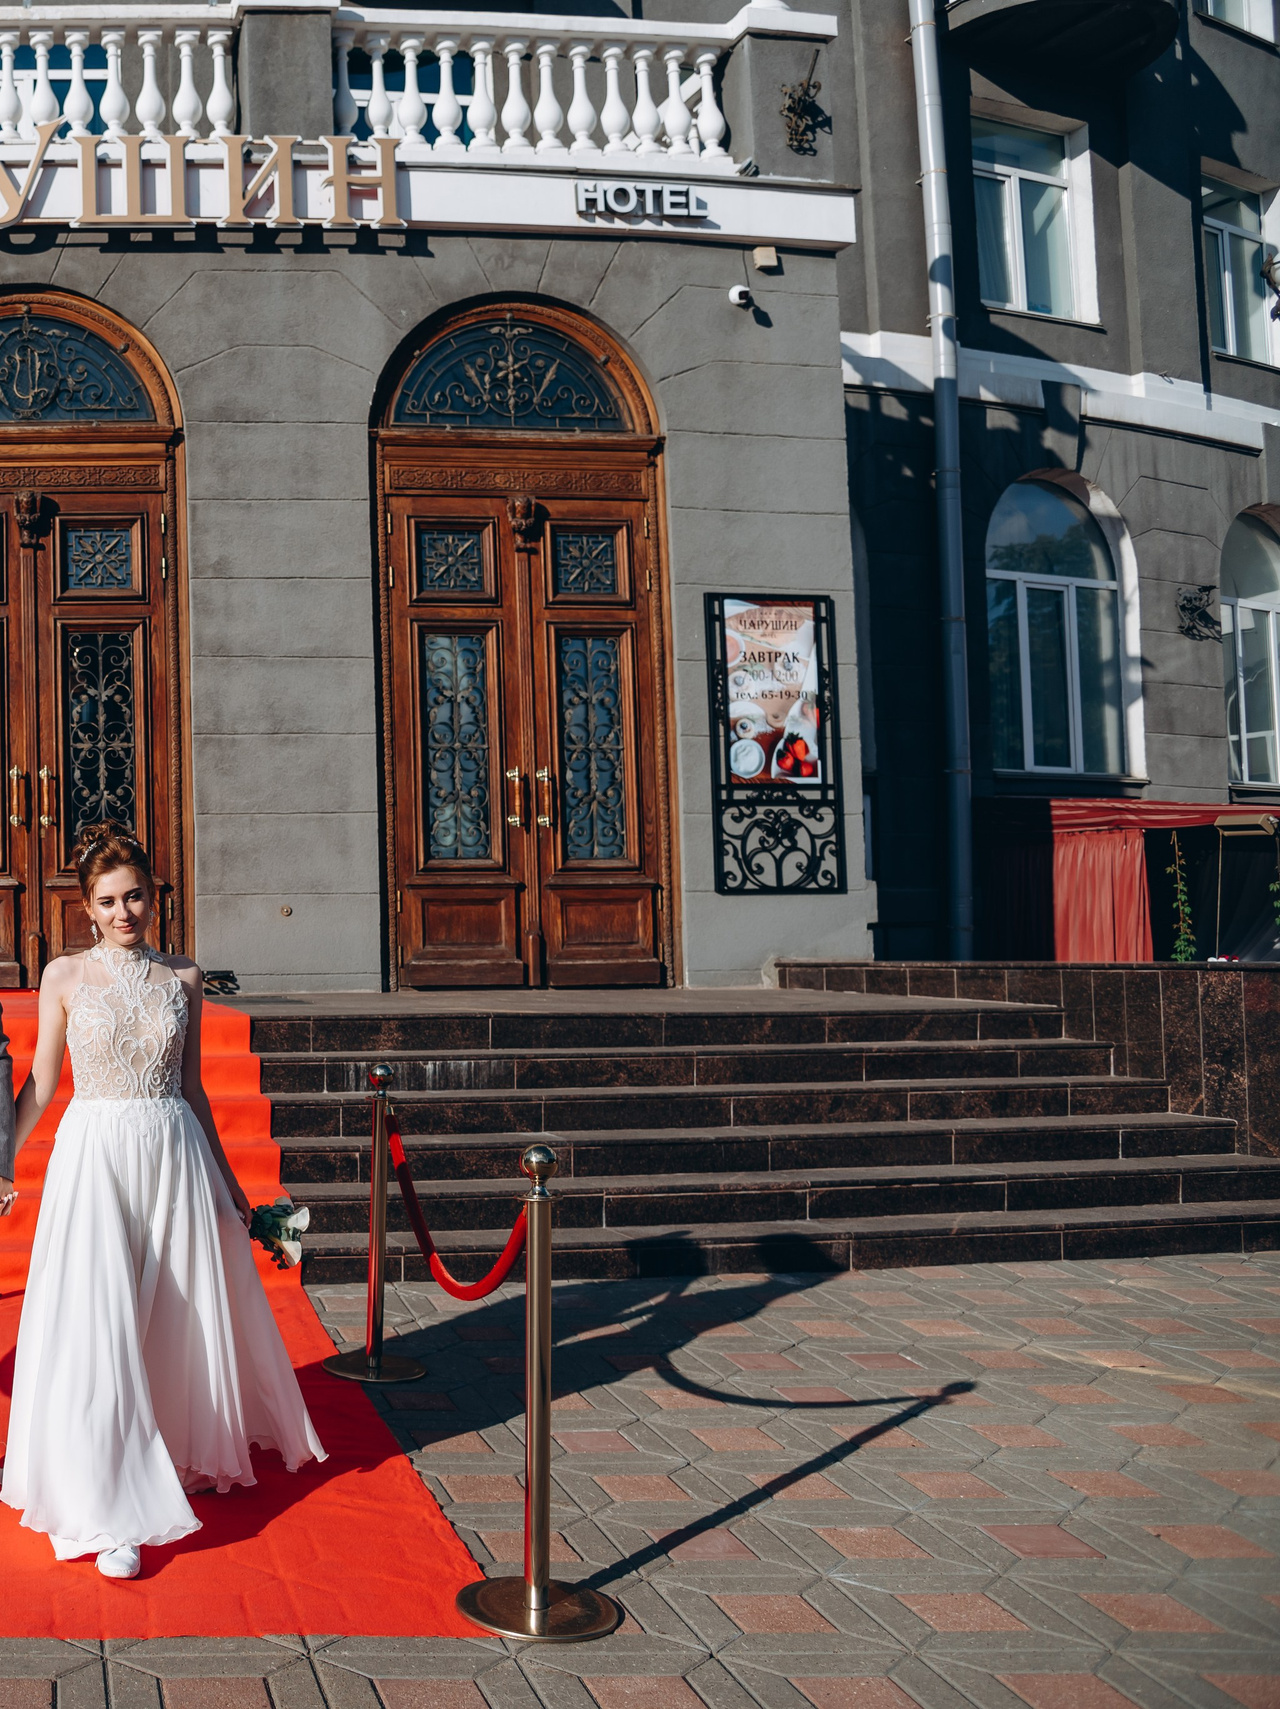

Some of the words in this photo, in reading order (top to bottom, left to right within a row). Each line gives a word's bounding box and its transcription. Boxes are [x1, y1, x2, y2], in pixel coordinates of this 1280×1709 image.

[576, 181, 710, 218] HOTEL
[739, 619, 798, 631] ЧАРУШИН
[739, 651, 800, 664] ЗАВТРАК
[761, 690, 808, 701] 65-19-30
